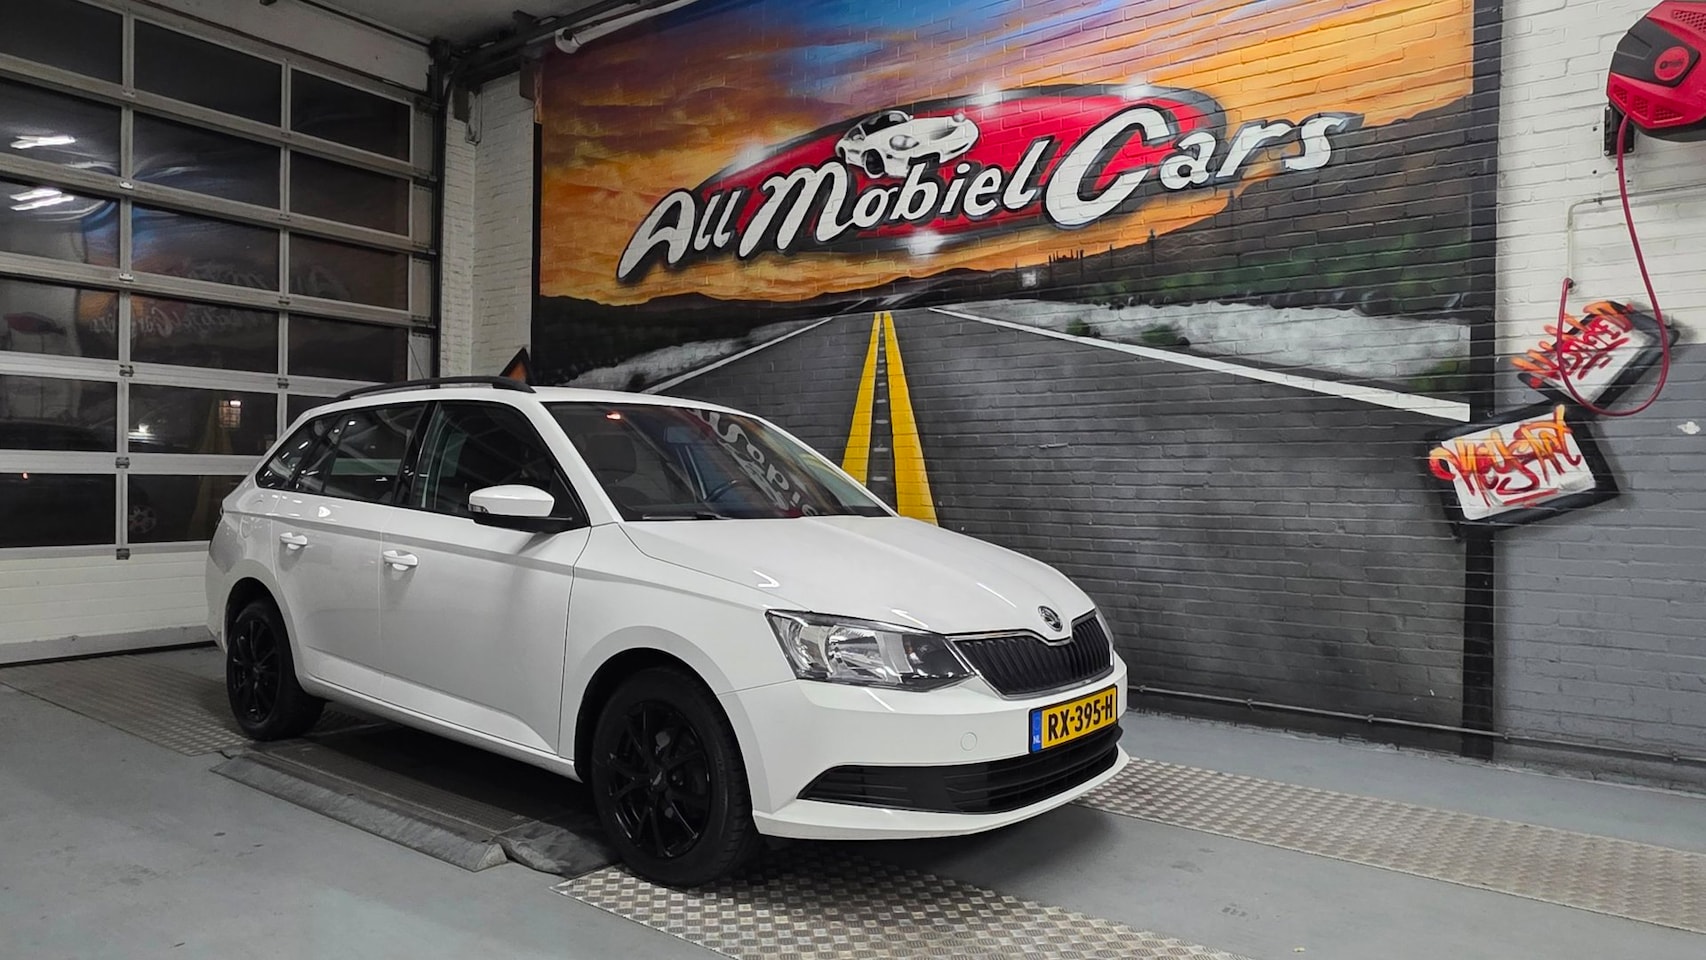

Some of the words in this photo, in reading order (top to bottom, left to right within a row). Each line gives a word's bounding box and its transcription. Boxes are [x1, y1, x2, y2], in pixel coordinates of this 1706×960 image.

[616, 188, 744, 280] All
[737, 136, 1053, 260] Mobiel
[1043, 104, 1355, 229] Cars
[1032, 734, 1041, 744] NL
[1047, 693, 1114, 742] RX-395-H
